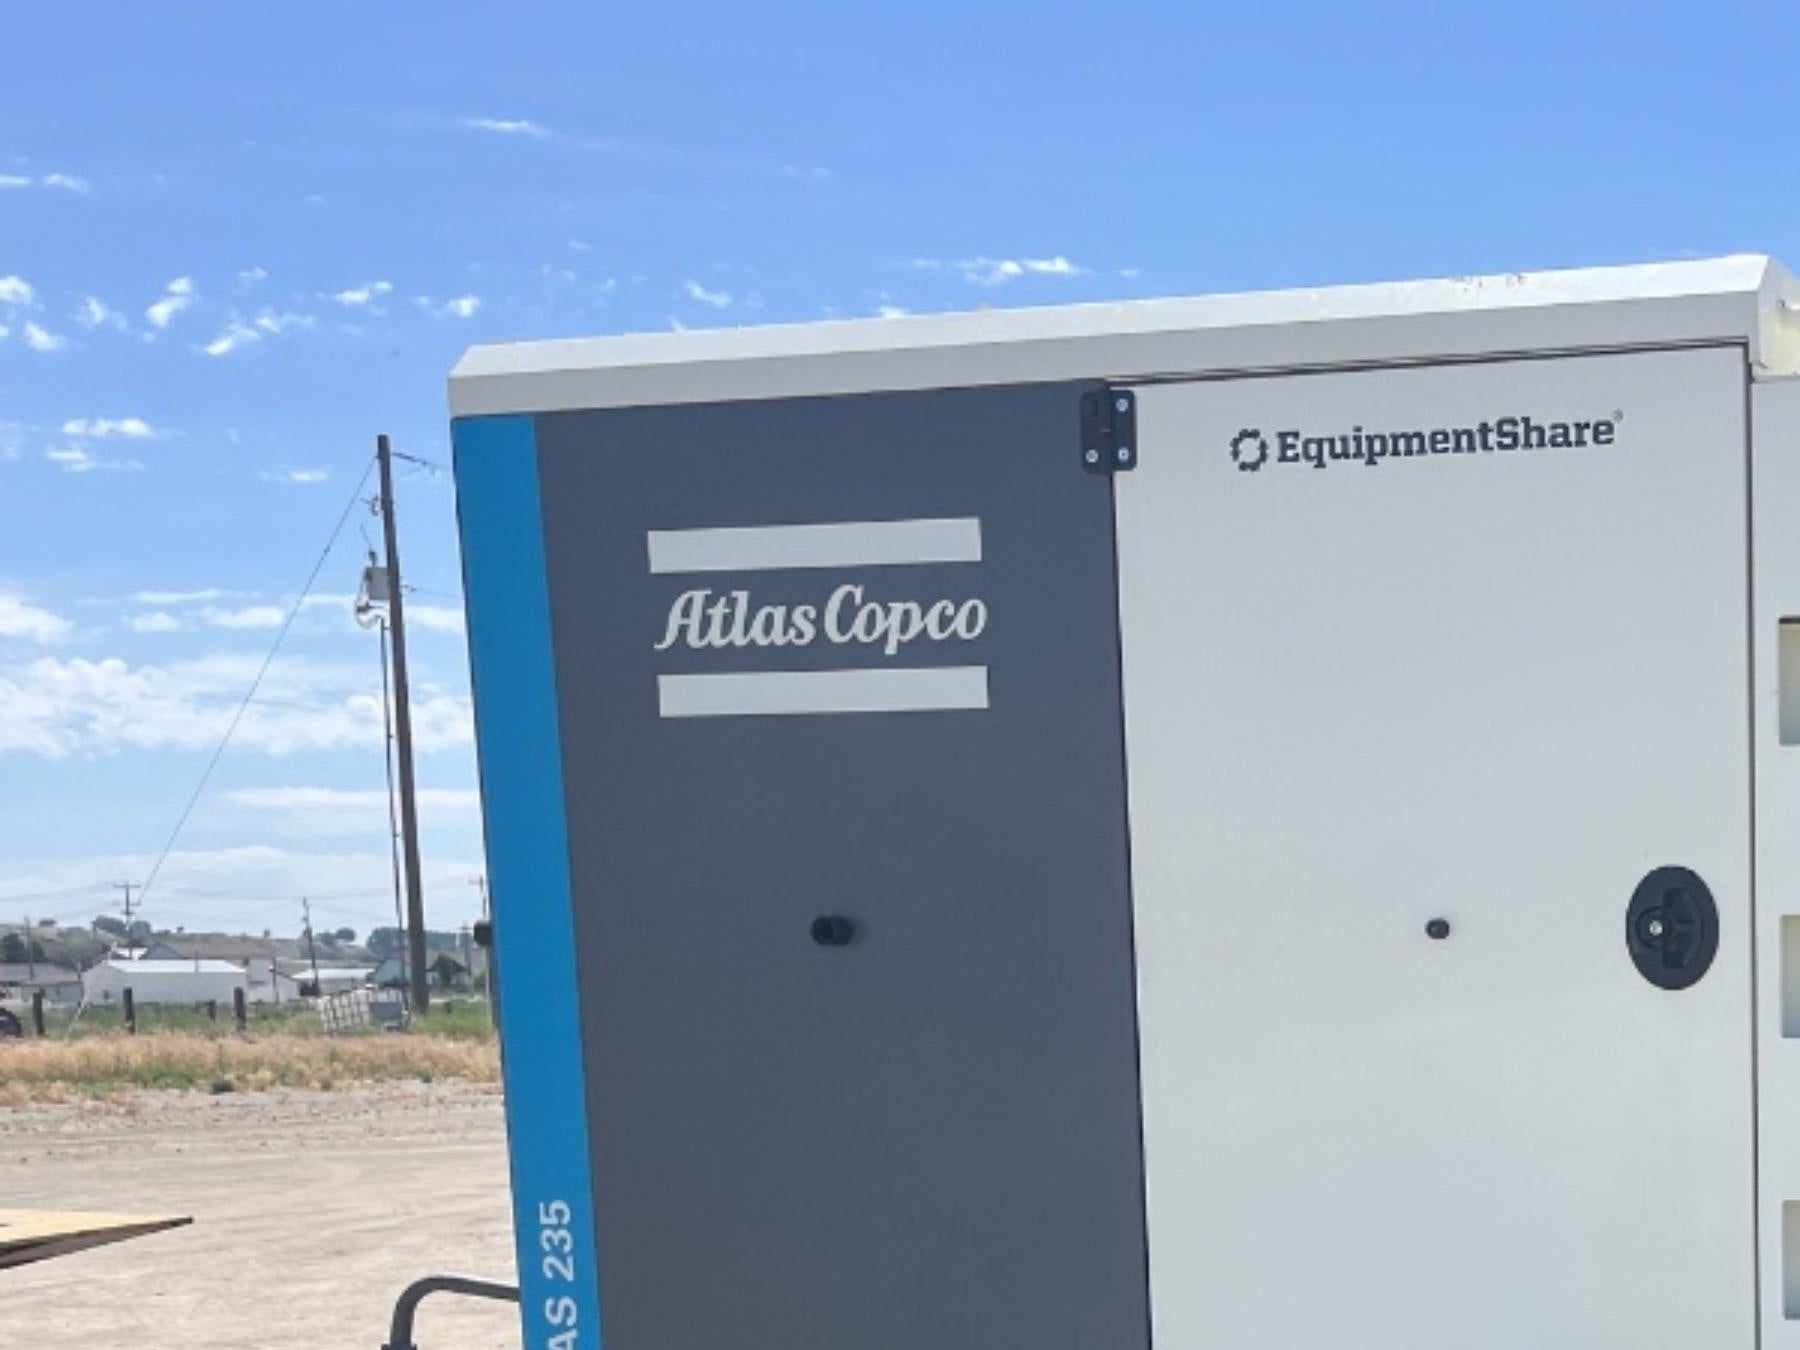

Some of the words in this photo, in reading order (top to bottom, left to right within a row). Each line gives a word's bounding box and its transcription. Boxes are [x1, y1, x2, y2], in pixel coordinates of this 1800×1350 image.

[1276, 416, 1616, 469] EquipmentShare
[654, 586, 817, 650] Atlas
[824, 584, 989, 655] Copco
[539, 1199, 575, 1282] 235
